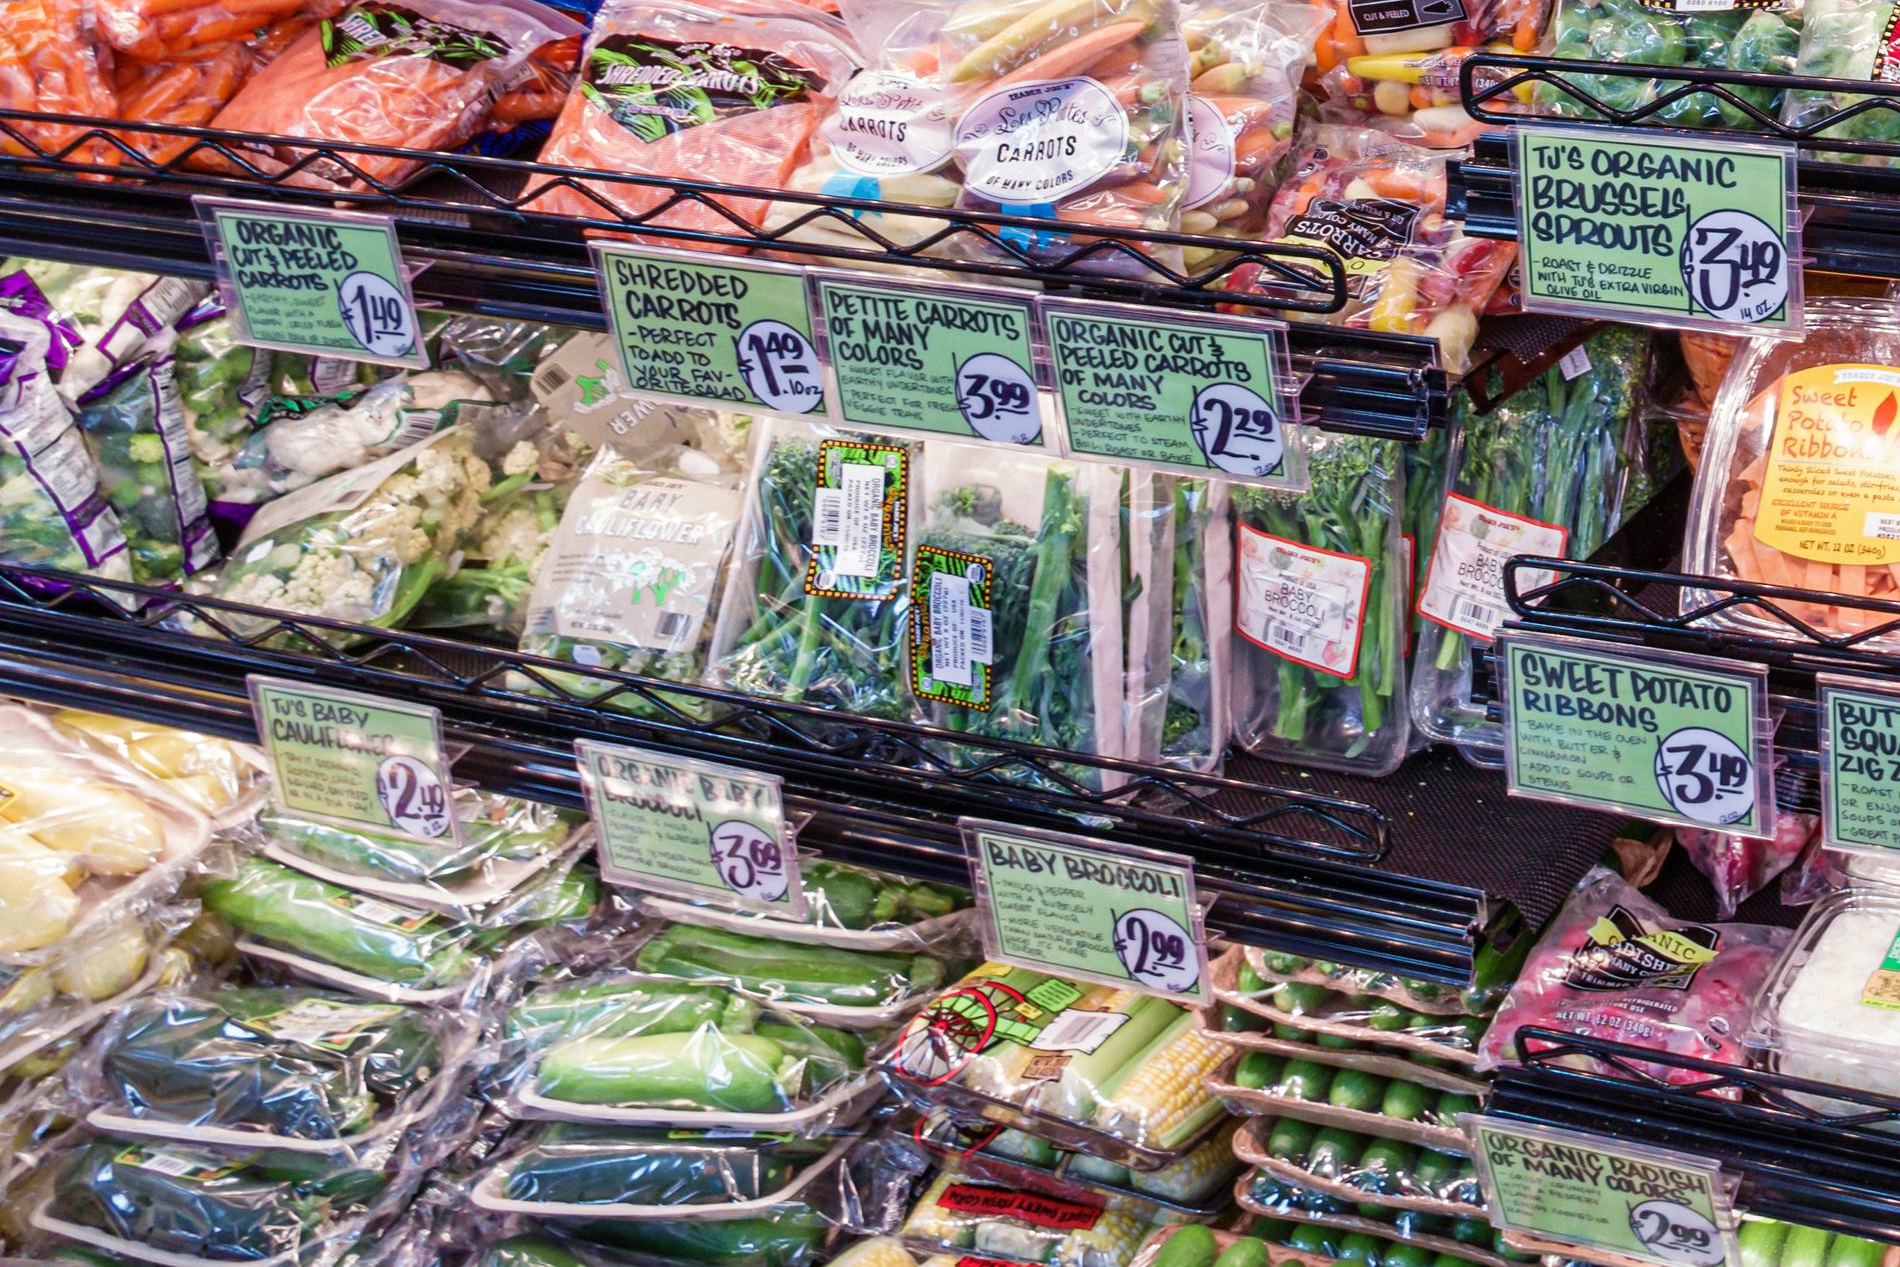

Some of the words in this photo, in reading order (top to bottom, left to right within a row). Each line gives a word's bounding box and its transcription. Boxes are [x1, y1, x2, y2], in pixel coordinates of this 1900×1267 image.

[996, 137, 1077, 165] CARROTS
[1533, 144, 1585, 171] TJ'S
[1592, 149, 1736, 189] ORGANIC
[1535, 175, 1688, 218] BRUSSELS
[238, 223, 342, 252] ORGANIC
[1533, 215, 1674, 256] SPROUTS
[233, 249, 266, 268] CUT
[279, 251, 358, 272] PEELED
[239, 268, 328, 292] CARROTS
[616, 261, 747, 300] SHREDDED
[626, 293, 740, 330] CARROTS
[830, 294, 915, 331] PETITE
[920, 305, 1019, 340] CARROTS
[640, 331, 716, 347] PERFECT
[831, 319, 857, 338] OF
[860, 324, 930, 352] MANY
[1056, 323, 1165, 356] ORGANIC
[1169, 336, 1206, 357] CUT
[841, 342, 923, 371] COLORS
[1059, 344, 1139, 370] PEELED
[1146, 353, 1251, 382] CARROTS
[1064, 369, 1090, 387] OF
[1094, 372, 1164, 394] MANY
[1792, 386, 1857, 408] Sweet
[1078, 391, 1155, 410] COLORS
[1265, 590, 1324, 621] BROCCOLI
[1281, 584, 1312, 603] BABY
[1521, 654, 1626, 695] SWEET
[1632, 668, 1732, 712] POTATO
[271, 698, 307, 718] TJ'S
[313, 701, 369, 727] BABY
[1523, 691, 1658, 732] RIBBONS
[1839, 754, 1884, 781] ZIG
[987, 843, 1055, 872] BABY
[1067, 856, 1179, 898] BROCCOLI
[1489, 1133, 1605, 1173] ORGANIC
[1610, 1157, 1706, 1193] RADISH
[1523, 1156, 1602, 1184] MANY
[1606, 1177, 1687, 1206] COLORS
